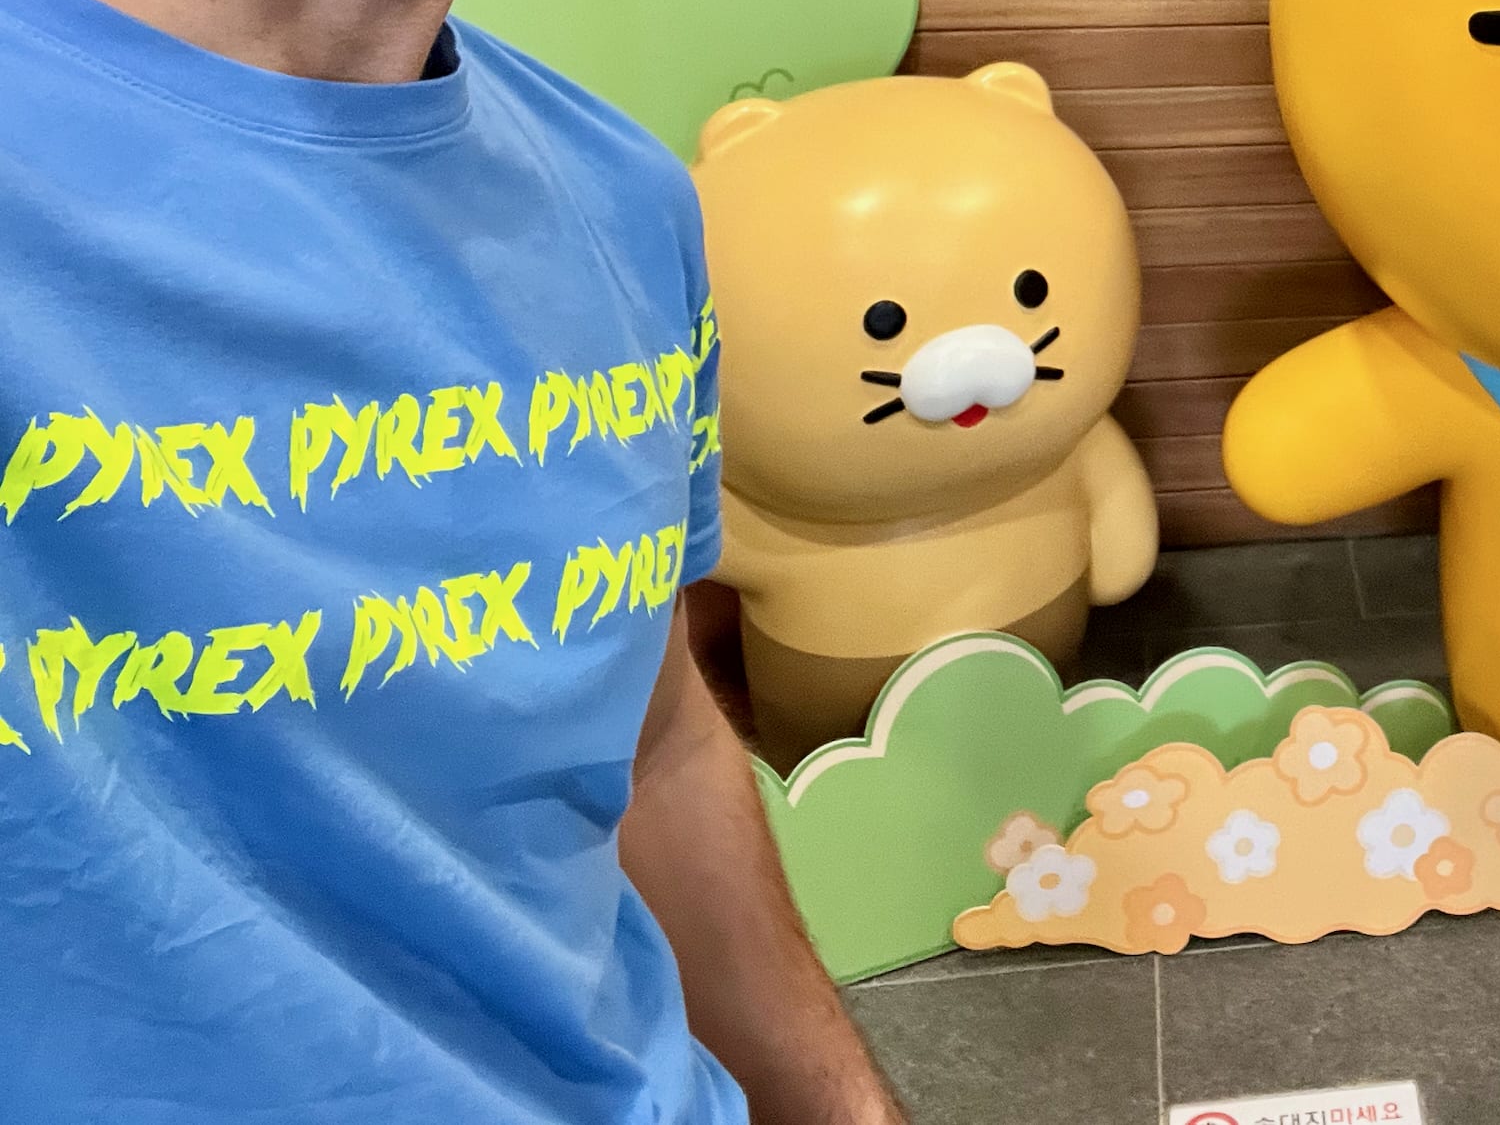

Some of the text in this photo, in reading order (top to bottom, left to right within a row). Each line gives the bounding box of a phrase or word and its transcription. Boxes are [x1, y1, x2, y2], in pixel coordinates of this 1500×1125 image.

[290, 382, 523, 513] PYREX
[27, 608, 323, 745] PYREX
[341, 562, 540, 703] PYREX
